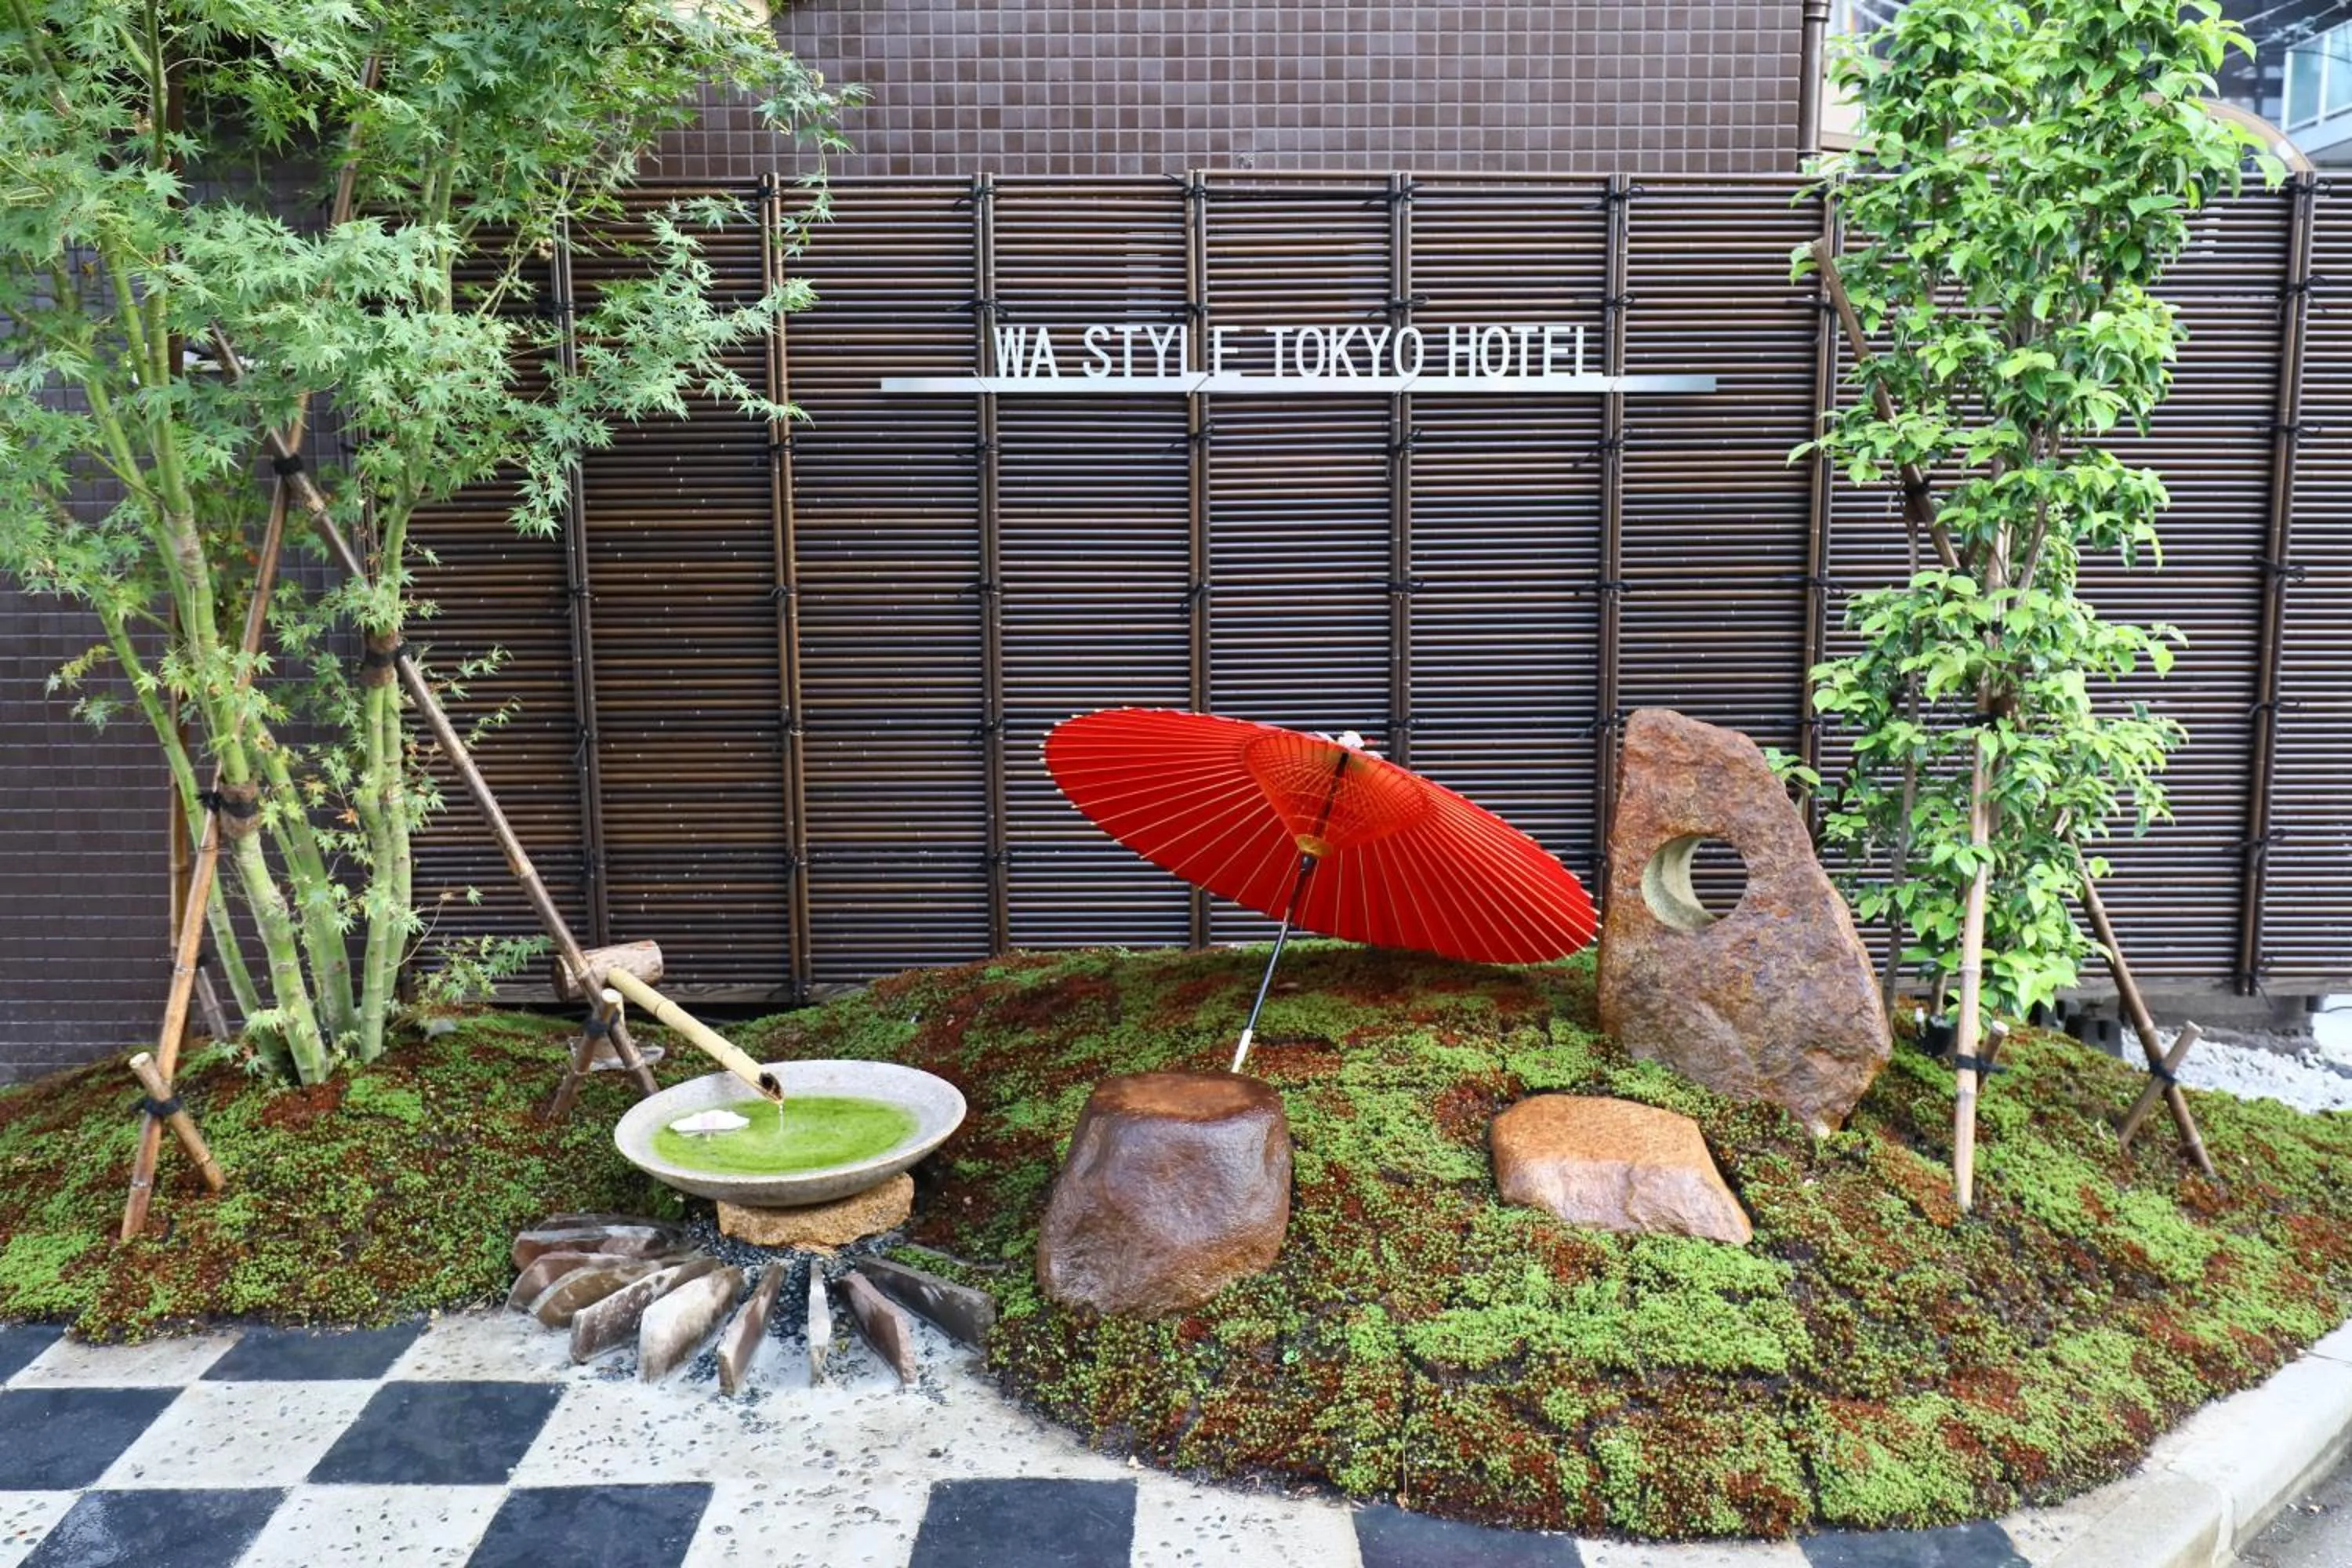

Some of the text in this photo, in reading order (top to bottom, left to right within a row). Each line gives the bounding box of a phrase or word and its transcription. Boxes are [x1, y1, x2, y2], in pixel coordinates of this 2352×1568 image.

[994, 325, 1603, 378] WA STYLE TOKYO HOTEL
